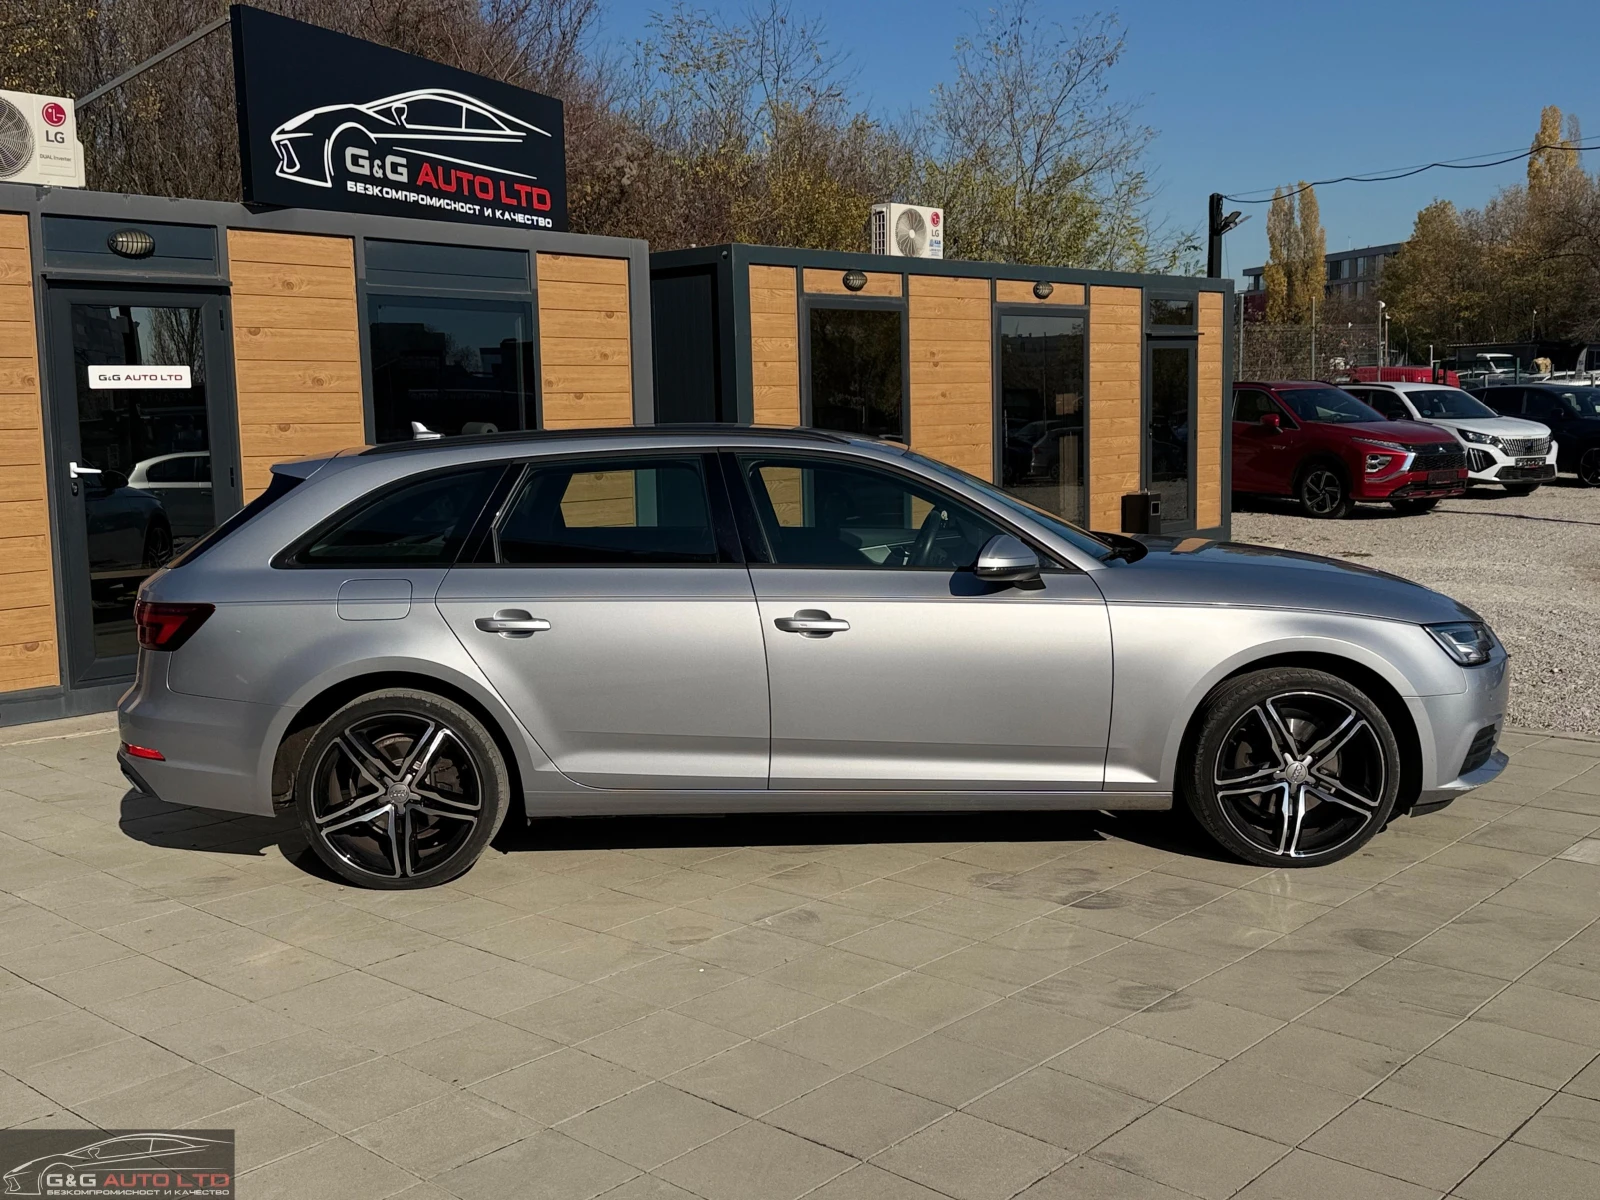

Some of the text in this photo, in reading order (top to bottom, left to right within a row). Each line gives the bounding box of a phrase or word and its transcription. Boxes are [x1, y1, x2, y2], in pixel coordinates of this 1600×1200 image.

[45, 130, 65, 144] LG
[345, 146, 552, 212] G&G AUTO LTD
[347, 181, 552, 228] БЕЗКОМПРОМИСНОСТ И КАЧЕСТВО
[932, 229, 940, 237] LG
